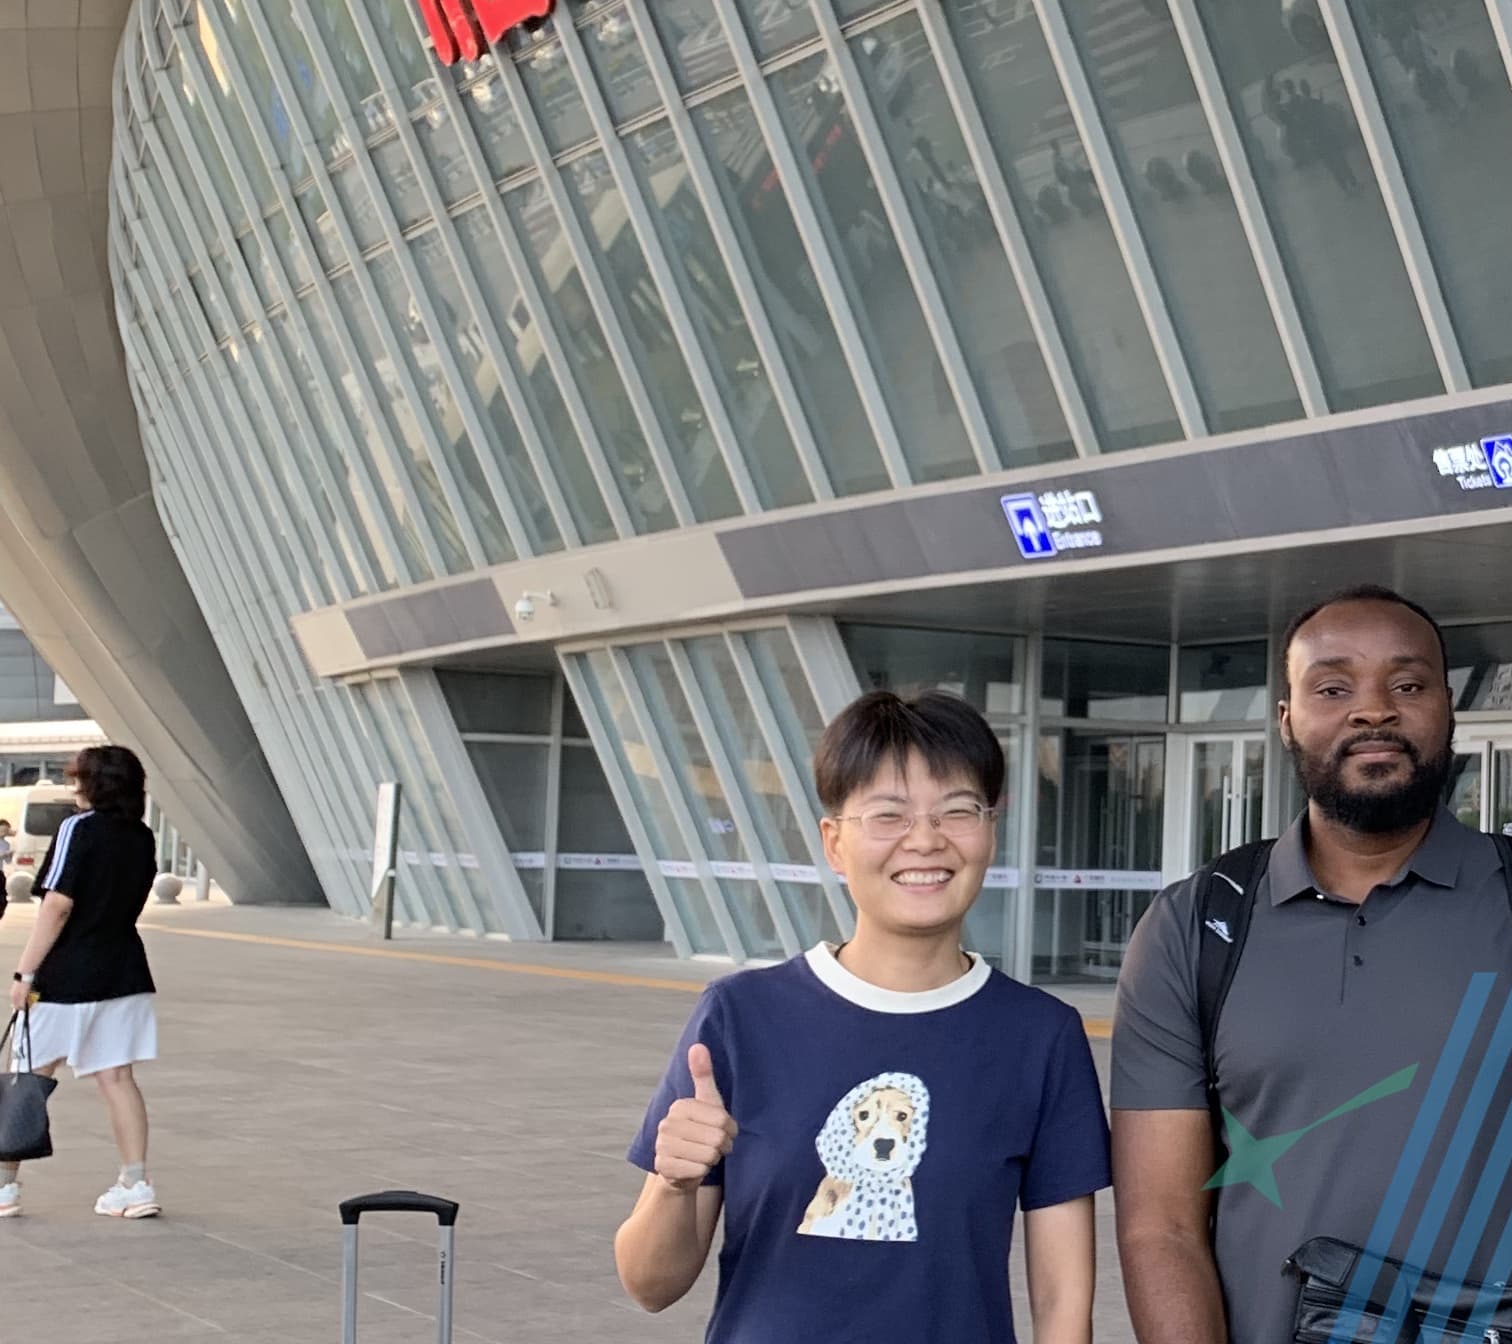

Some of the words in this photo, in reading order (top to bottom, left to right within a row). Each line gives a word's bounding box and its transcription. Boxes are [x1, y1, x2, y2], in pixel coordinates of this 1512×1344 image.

[1433, 441, 1488, 475] 售票处
[1038, 489, 1102, 528] 进站口
[1052, 530, 1102, 550] Entrance
